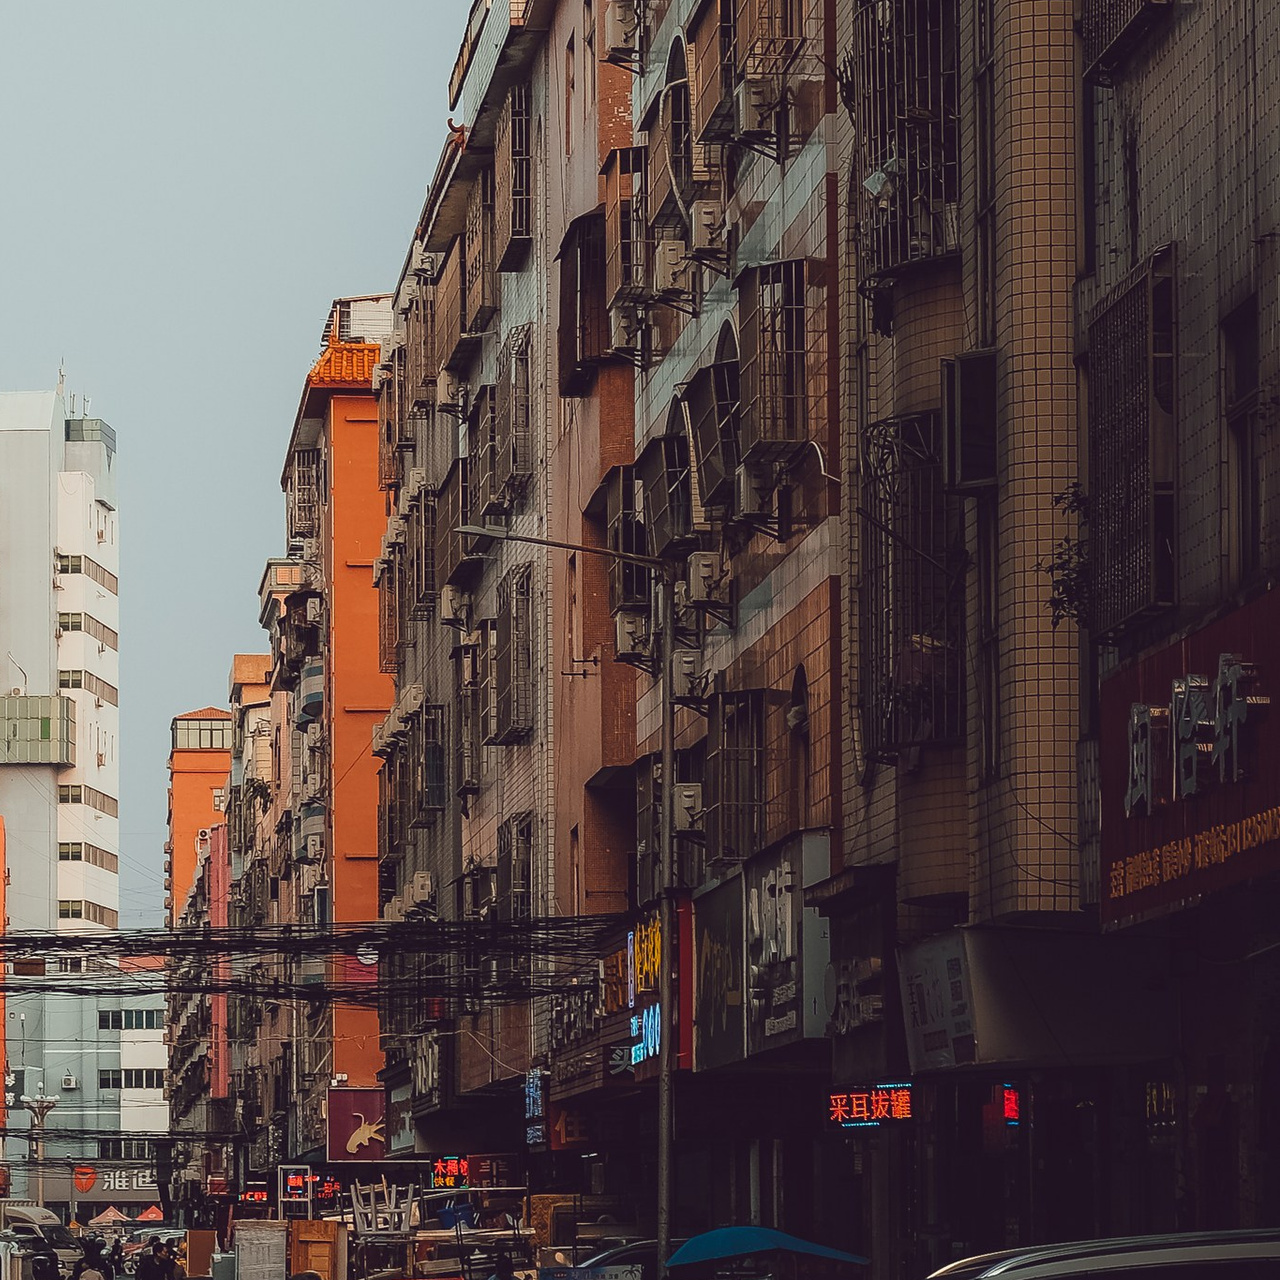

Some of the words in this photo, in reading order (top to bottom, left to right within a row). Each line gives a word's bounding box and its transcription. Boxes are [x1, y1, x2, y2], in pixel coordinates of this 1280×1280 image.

[829, 1089, 912, 1122] 采耳拔罐
[102, 1169, 158, 1192] 雅迪
